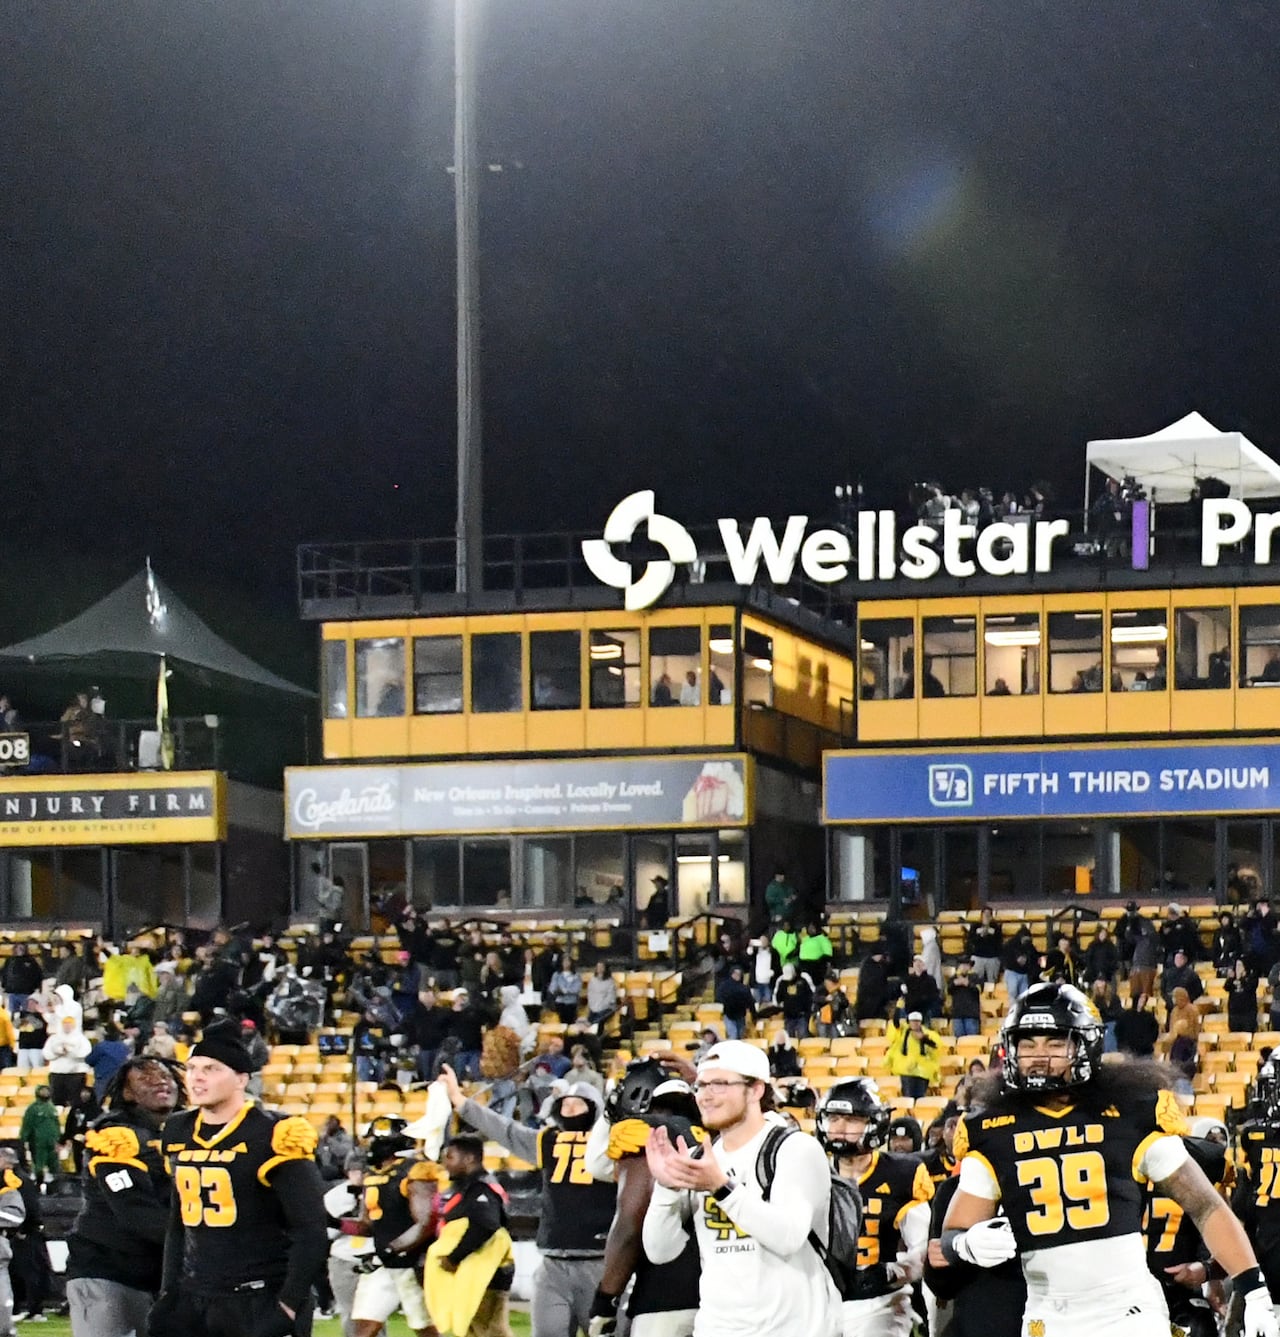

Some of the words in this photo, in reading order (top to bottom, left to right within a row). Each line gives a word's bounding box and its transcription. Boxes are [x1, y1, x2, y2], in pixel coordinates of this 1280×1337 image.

[717, 508, 1069, 585] Wellstar
[414, 787, 445, 801] New
[450, 786, 501, 801] Orleans
[504, 783, 563, 802] Inspired.
[567, 781, 615, 800] Locally
[619, 780, 664, 797] Loved.
[983, 772, 1058, 795] FIFTH
[1068, 770, 1151, 793] THIRD
[1159, 767, 1270, 791] STADIUM
[5, 796, 104, 818] NJURY
[128, 793, 206, 812] FIRM
[1013, 1124, 1104, 1153] OWLS
[105, 1168, 134, 1193] 61
[1014, 1150, 1110, 1236] 39
[175, 1166, 238, 1228] 83
